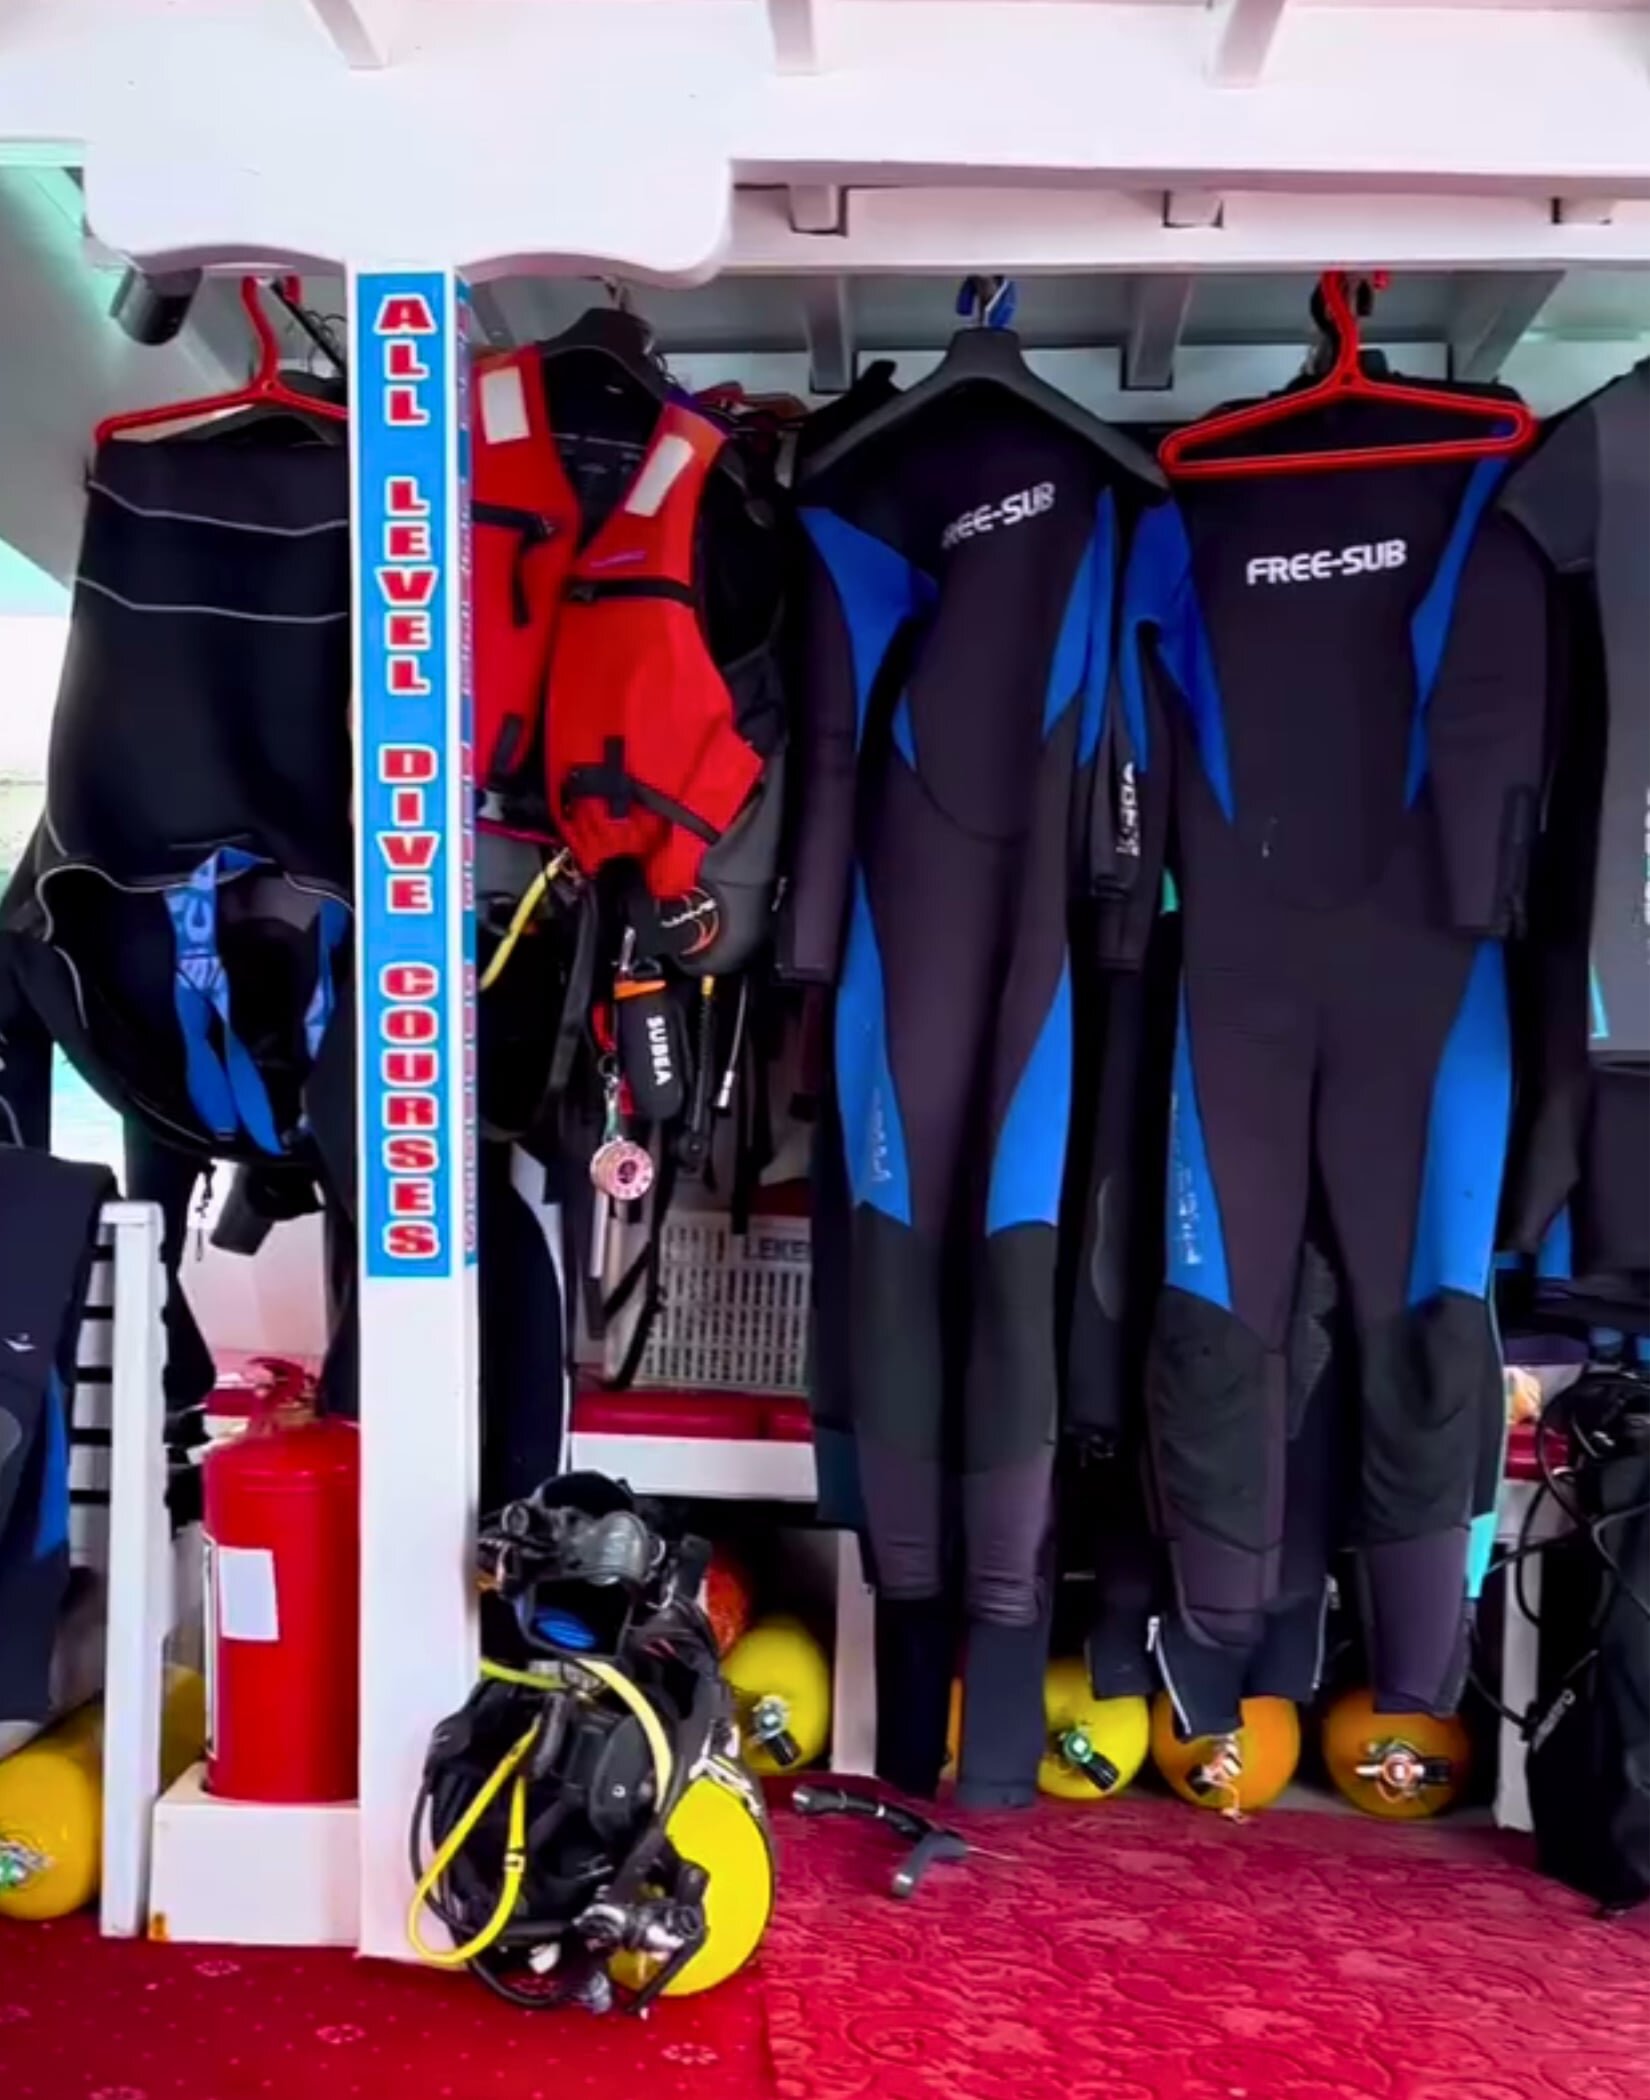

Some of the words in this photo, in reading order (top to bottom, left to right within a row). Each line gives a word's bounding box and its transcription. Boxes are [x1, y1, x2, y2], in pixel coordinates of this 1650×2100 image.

[374, 294, 437, 426] ALL
[942, 481, 1055, 549] REE-SUB
[1246, 539, 1406, 585] FREE-SUB
[376, 476, 438, 695] LEVEL
[375, 744, 440, 914] DIVE
[379, 962, 441, 1260] COURSES
[646, 1015, 673, 1086] SUBEA
